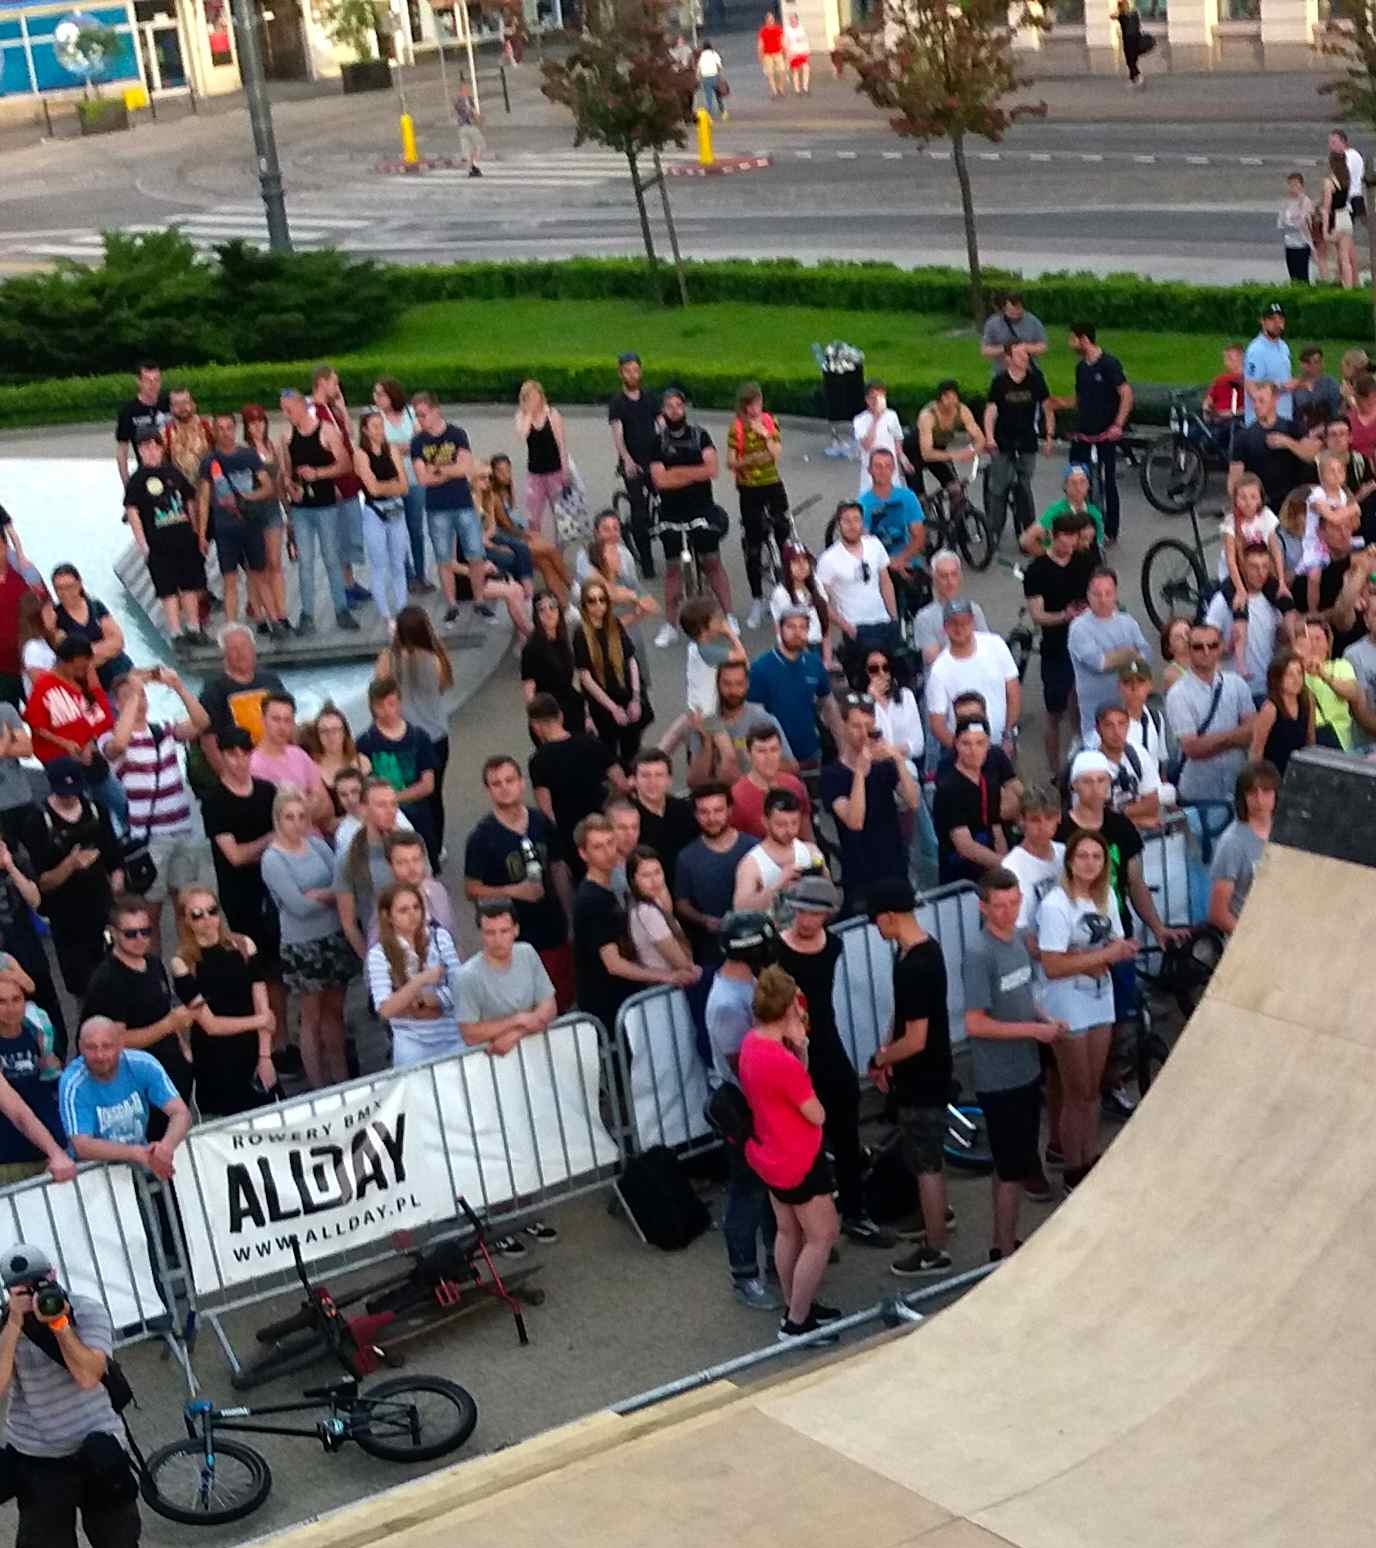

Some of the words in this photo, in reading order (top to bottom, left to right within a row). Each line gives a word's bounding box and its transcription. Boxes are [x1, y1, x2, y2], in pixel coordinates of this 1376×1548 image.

[231, 1122, 332, 1150] ROWERY
[343, 1099, 382, 1129] BMX
[226, 1112, 406, 1234] ALLDAY
